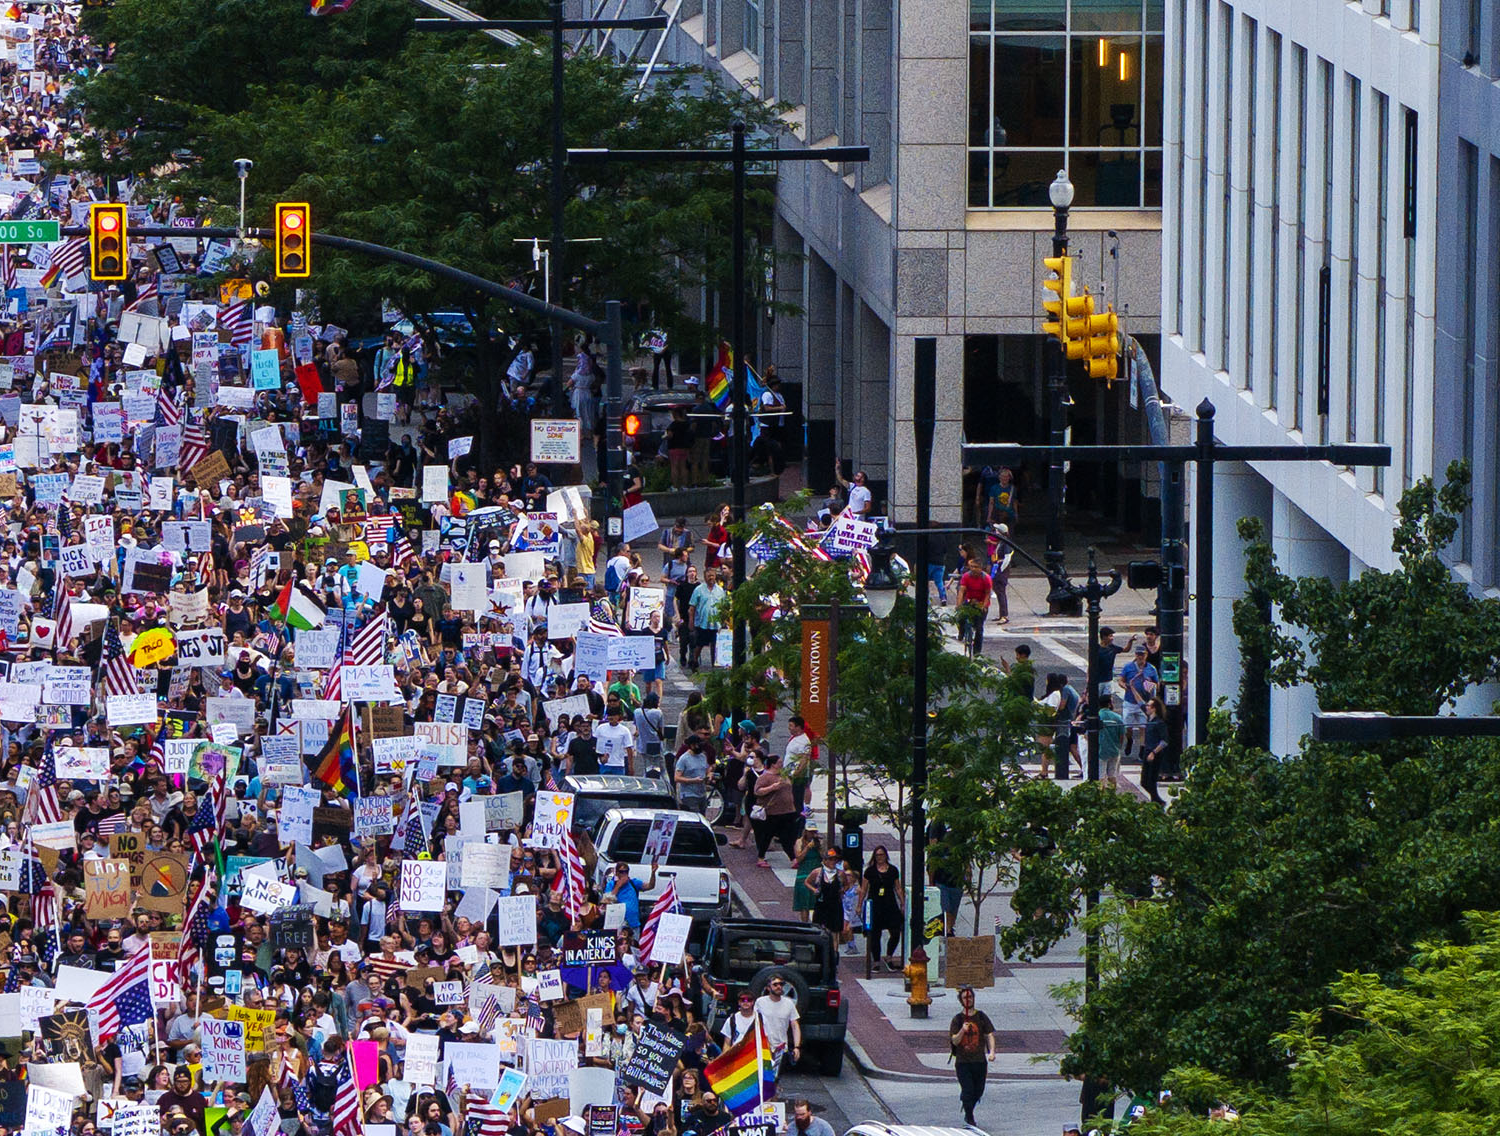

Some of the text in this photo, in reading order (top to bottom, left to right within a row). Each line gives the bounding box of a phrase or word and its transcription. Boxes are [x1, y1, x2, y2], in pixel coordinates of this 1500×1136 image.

[141, 639, 163, 654] TACO
[810, 630, 821, 704] DOWNTOWN
[203, 1021, 220, 1035] NO
[213, 1038, 241, 1051] KINGS
[209, 1052, 239, 1063] SINCE
[214, 1064, 241, 1076] 1776
